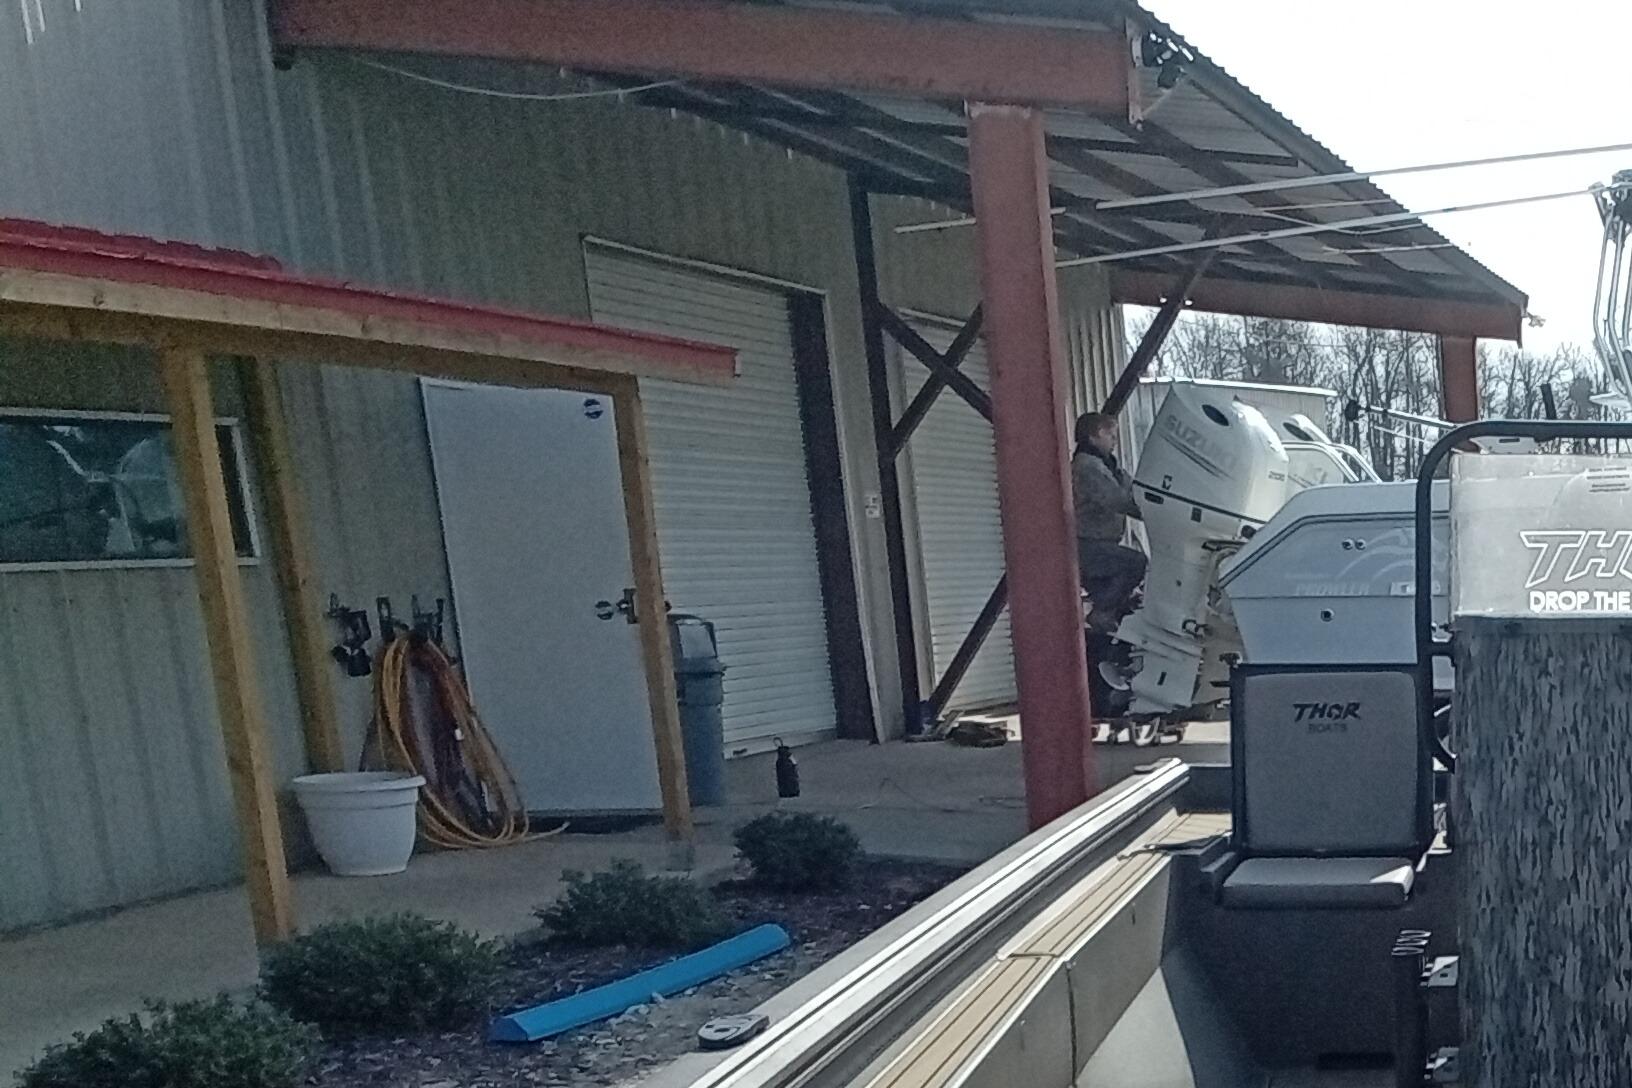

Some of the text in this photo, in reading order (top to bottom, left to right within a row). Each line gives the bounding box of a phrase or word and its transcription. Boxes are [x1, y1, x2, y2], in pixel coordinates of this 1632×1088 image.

[1529, 590, 1590, 612] DROP
[1594, 590, 1631, 611] THE
[1292, 702, 1361, 722] THOR
